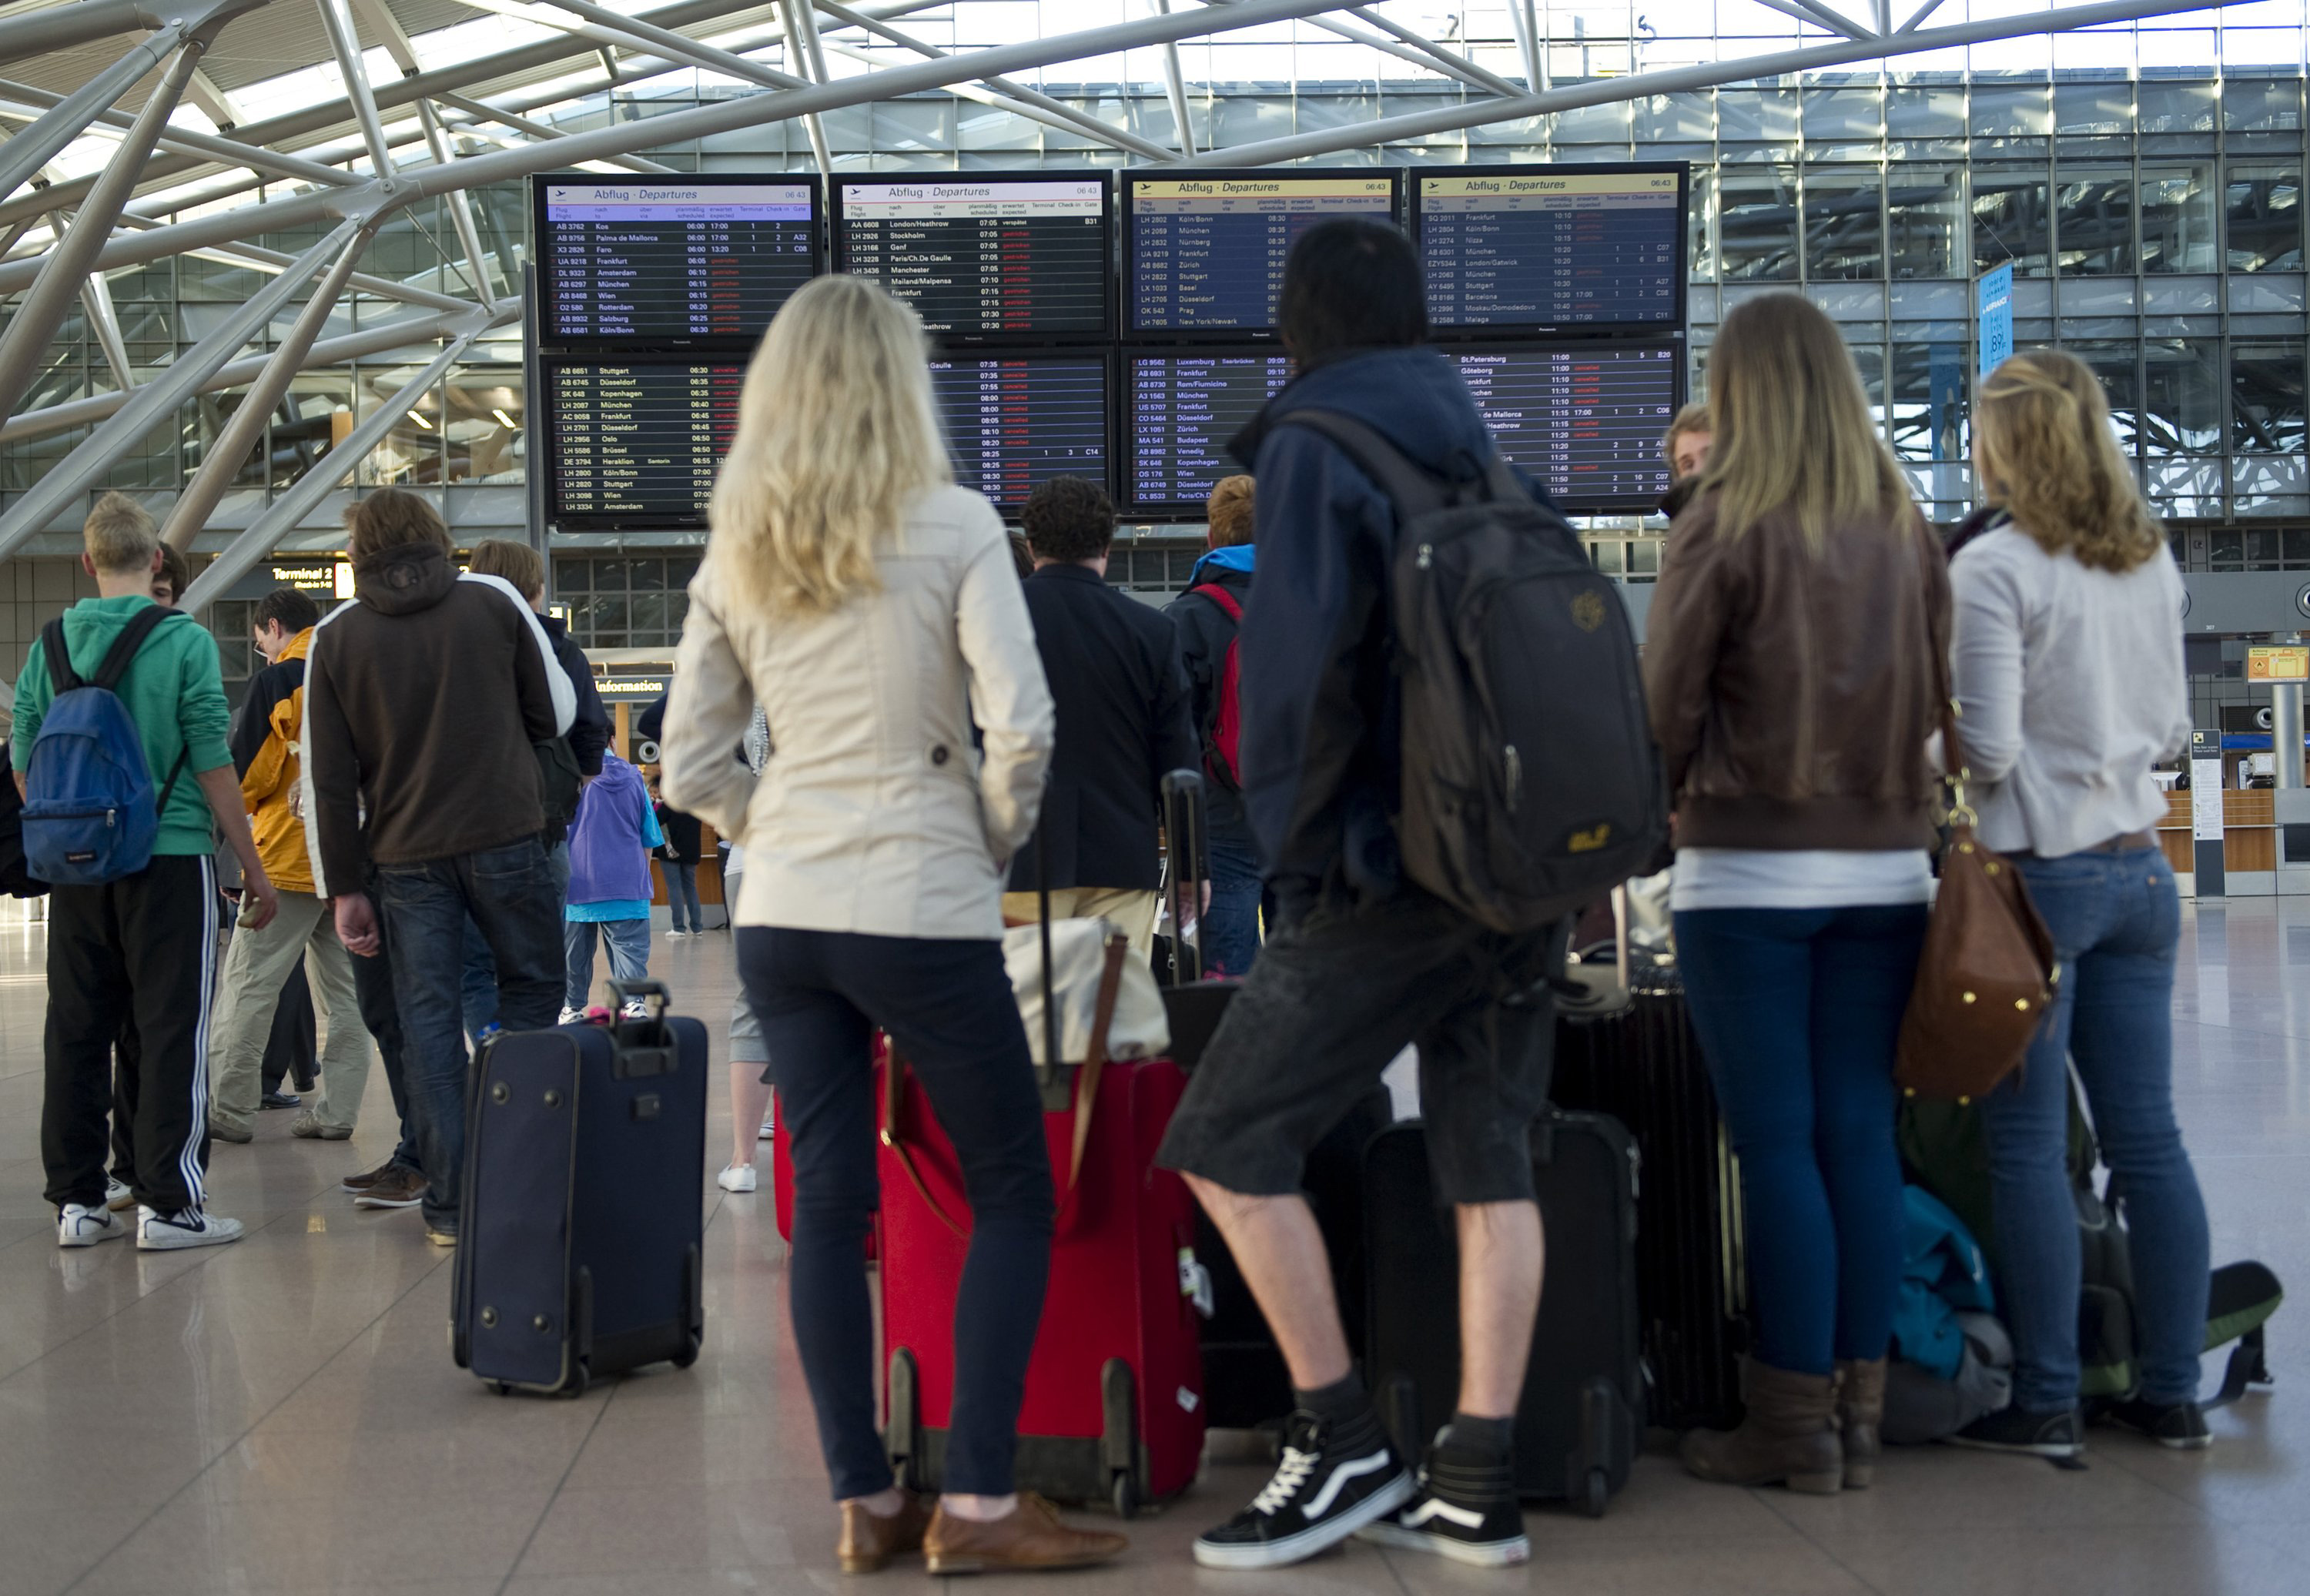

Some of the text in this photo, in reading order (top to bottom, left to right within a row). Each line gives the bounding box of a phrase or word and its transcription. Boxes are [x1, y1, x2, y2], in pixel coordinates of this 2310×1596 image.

[1179, 183, 1212, 193] Abflug
[1222, 183, 1279, 193] Departures
[1466, 181, 1565, 192] Abflug Departures
[594, 189, 698, 200] Abflug Departures
[889, 188, 990, 199] Abflug Departures
[273, 567, 333, 580] Terminal 2
[595, 680, 662, 692] Information
